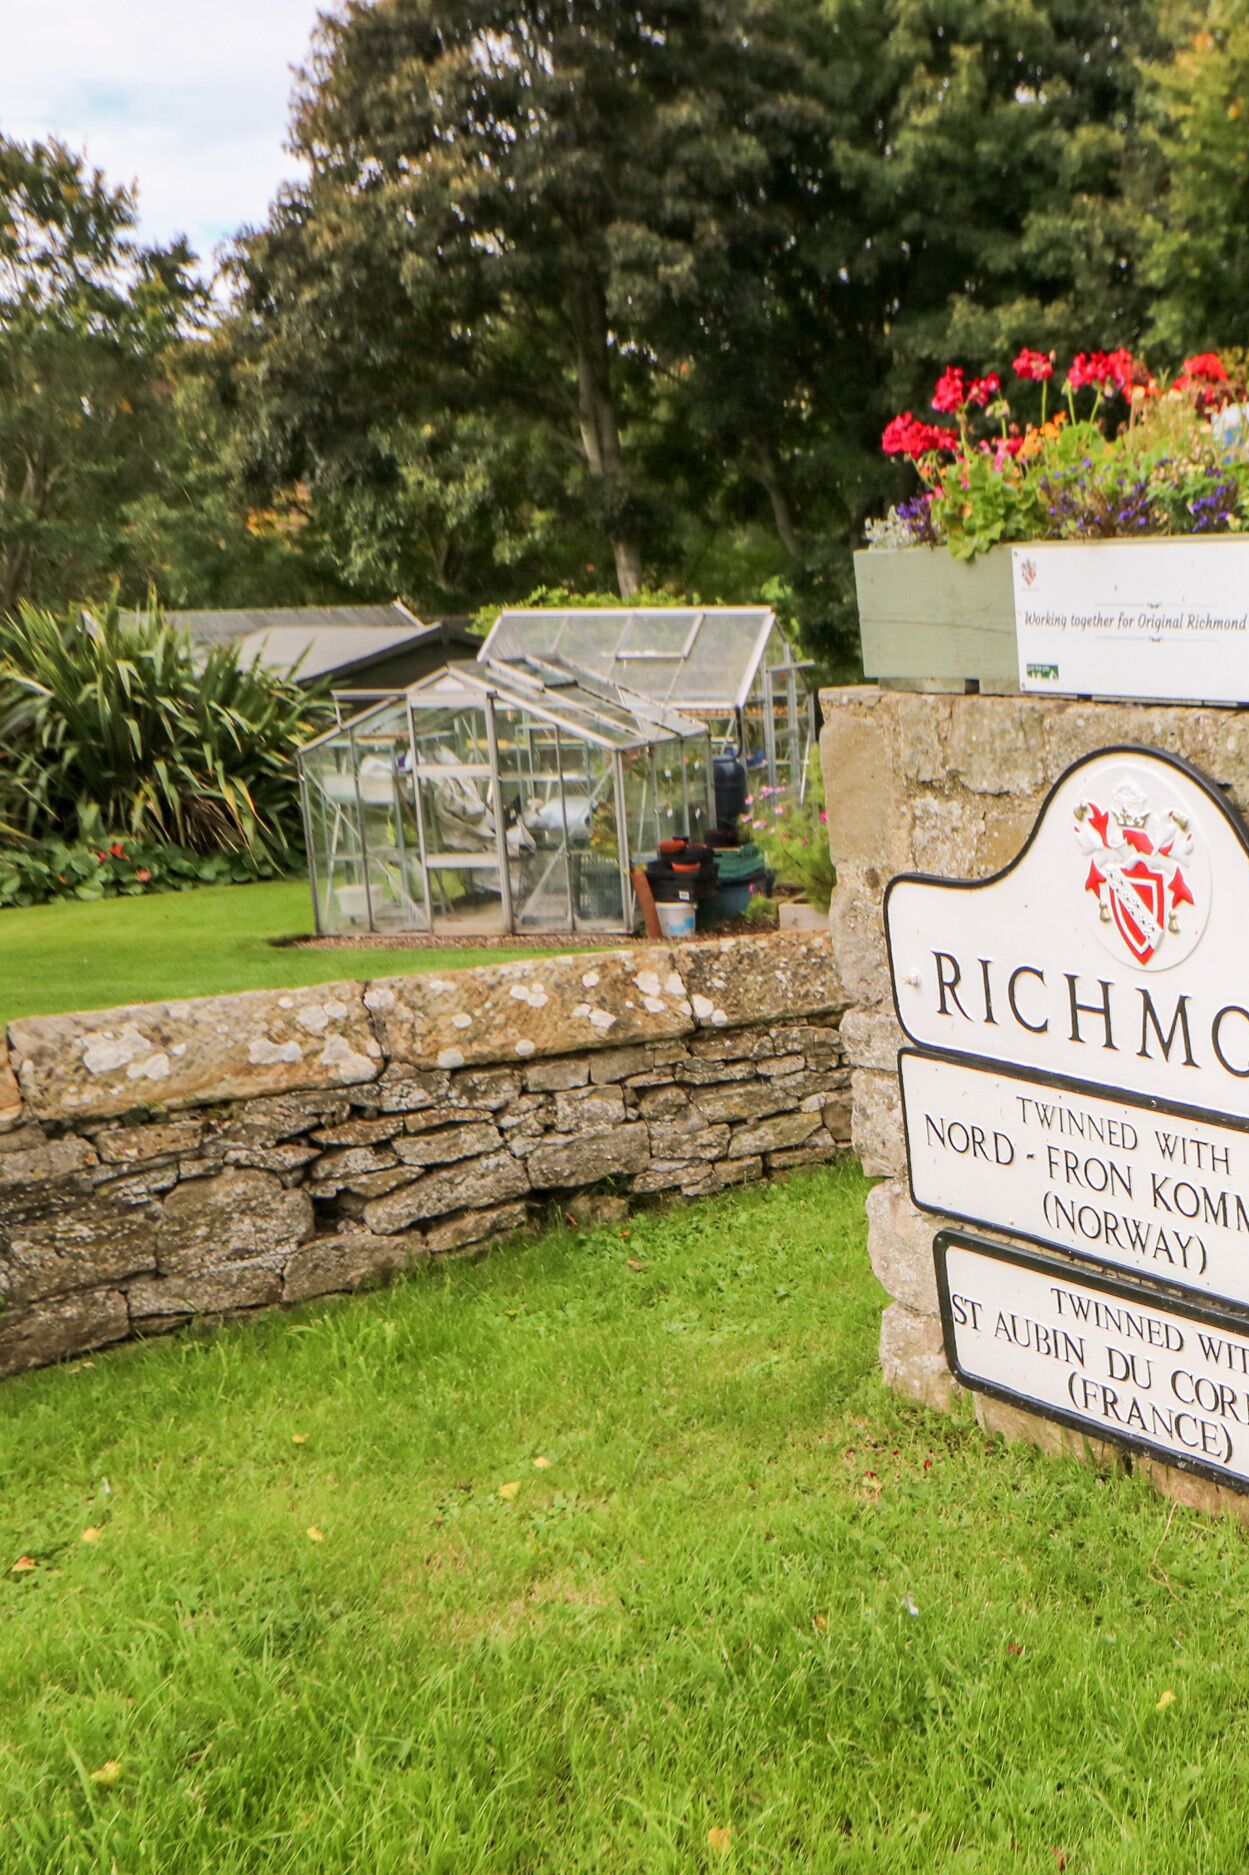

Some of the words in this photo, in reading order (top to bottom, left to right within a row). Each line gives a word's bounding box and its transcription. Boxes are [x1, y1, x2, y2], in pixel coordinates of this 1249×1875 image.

[1024, 613, 1067, 631] Working
[1070, 614, 1114, 633] together
[1117, 613, 1134, 629] for
[1137, 614, 1183, 632] Original
[1187, 614, 1247, 631] Richmond
[924, 1113, 1014, 1166] NORD
[1047, 1145, 1133, 1200] FRON
[1016, 1096, 1138, 1151] TWINNED
[1154, 1130, 1232, 1176] WITH
[1043, 1191, 1208, 1276] (NORWAY)
[952, 1293, 983, 1331] ST
[994, 1310, 1086, 1368] AUBIN
[1106, 1345, 1153, 1390] DU
[1050, 1287, 1184, 1352] TWINNED
[1068, 1371, 1234, 1464] (FRANCE)
